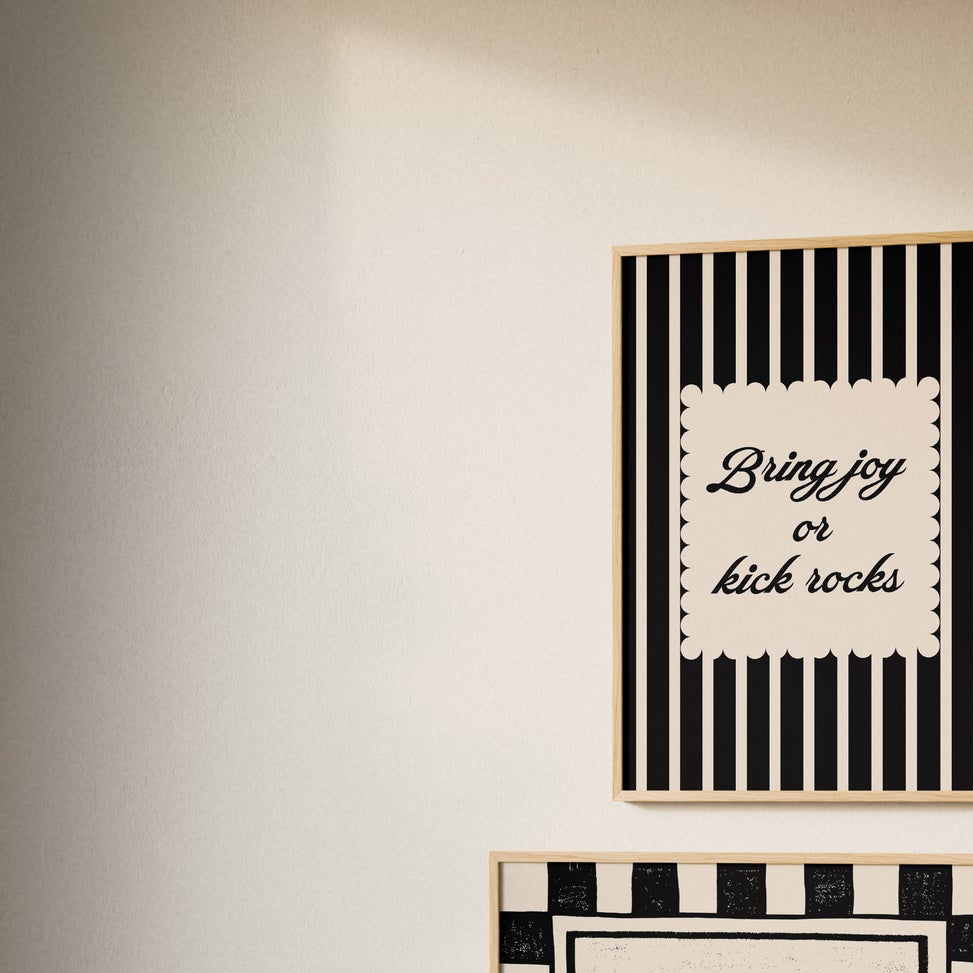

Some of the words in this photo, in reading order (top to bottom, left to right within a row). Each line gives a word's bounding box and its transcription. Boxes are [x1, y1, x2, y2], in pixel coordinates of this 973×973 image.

[705, 446, 838, 503] Bring
[815, 448, 907, 502] joy
[792, 516, 834, 543] or
[710, 554, 801, 595] kick
[805, 552, 905, 594] rocks
